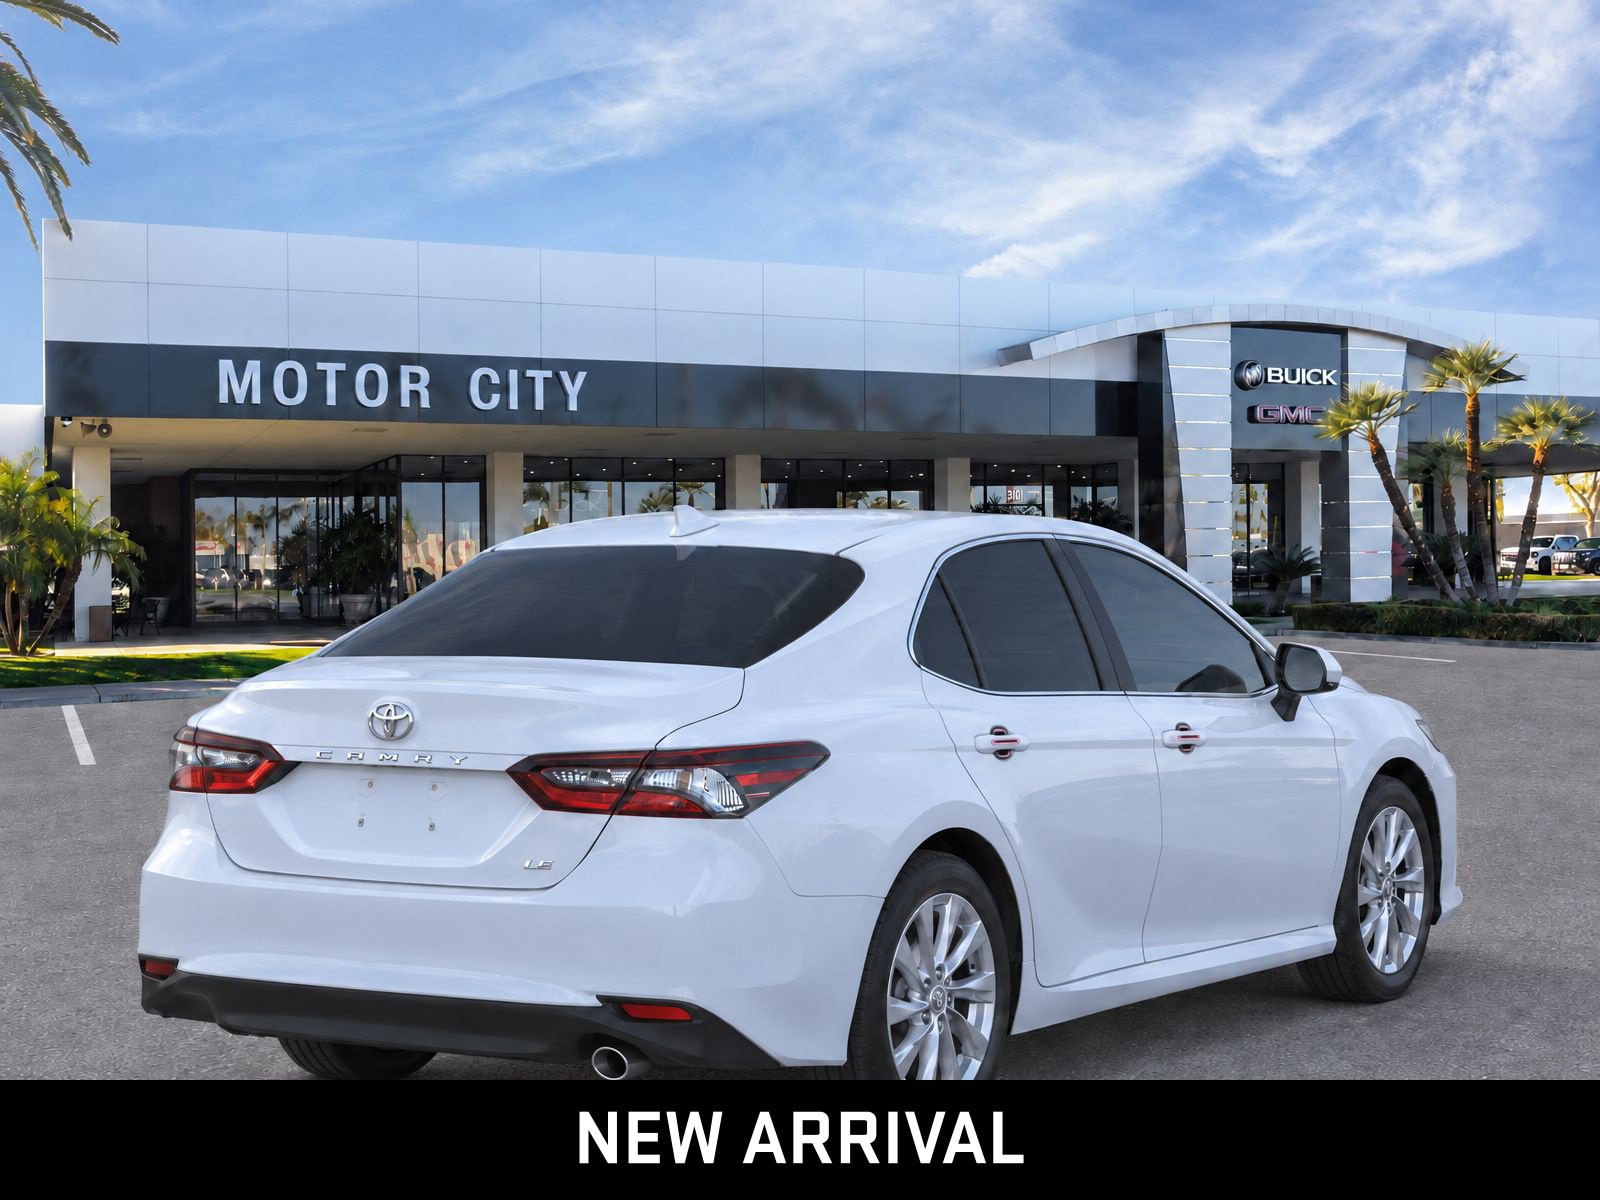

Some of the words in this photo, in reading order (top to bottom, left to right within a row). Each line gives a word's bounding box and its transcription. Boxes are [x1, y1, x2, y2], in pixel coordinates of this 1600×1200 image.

[217, 359, 431, 409] MOTOR
[468, 366, 588, 411] CITY
[1267, 367, 1338, 385] BUICK
[1256, 405, 1326, 423] GMC
[316, 751, 468, 765] CAMRY
[523, 860, 554, 870] LE
